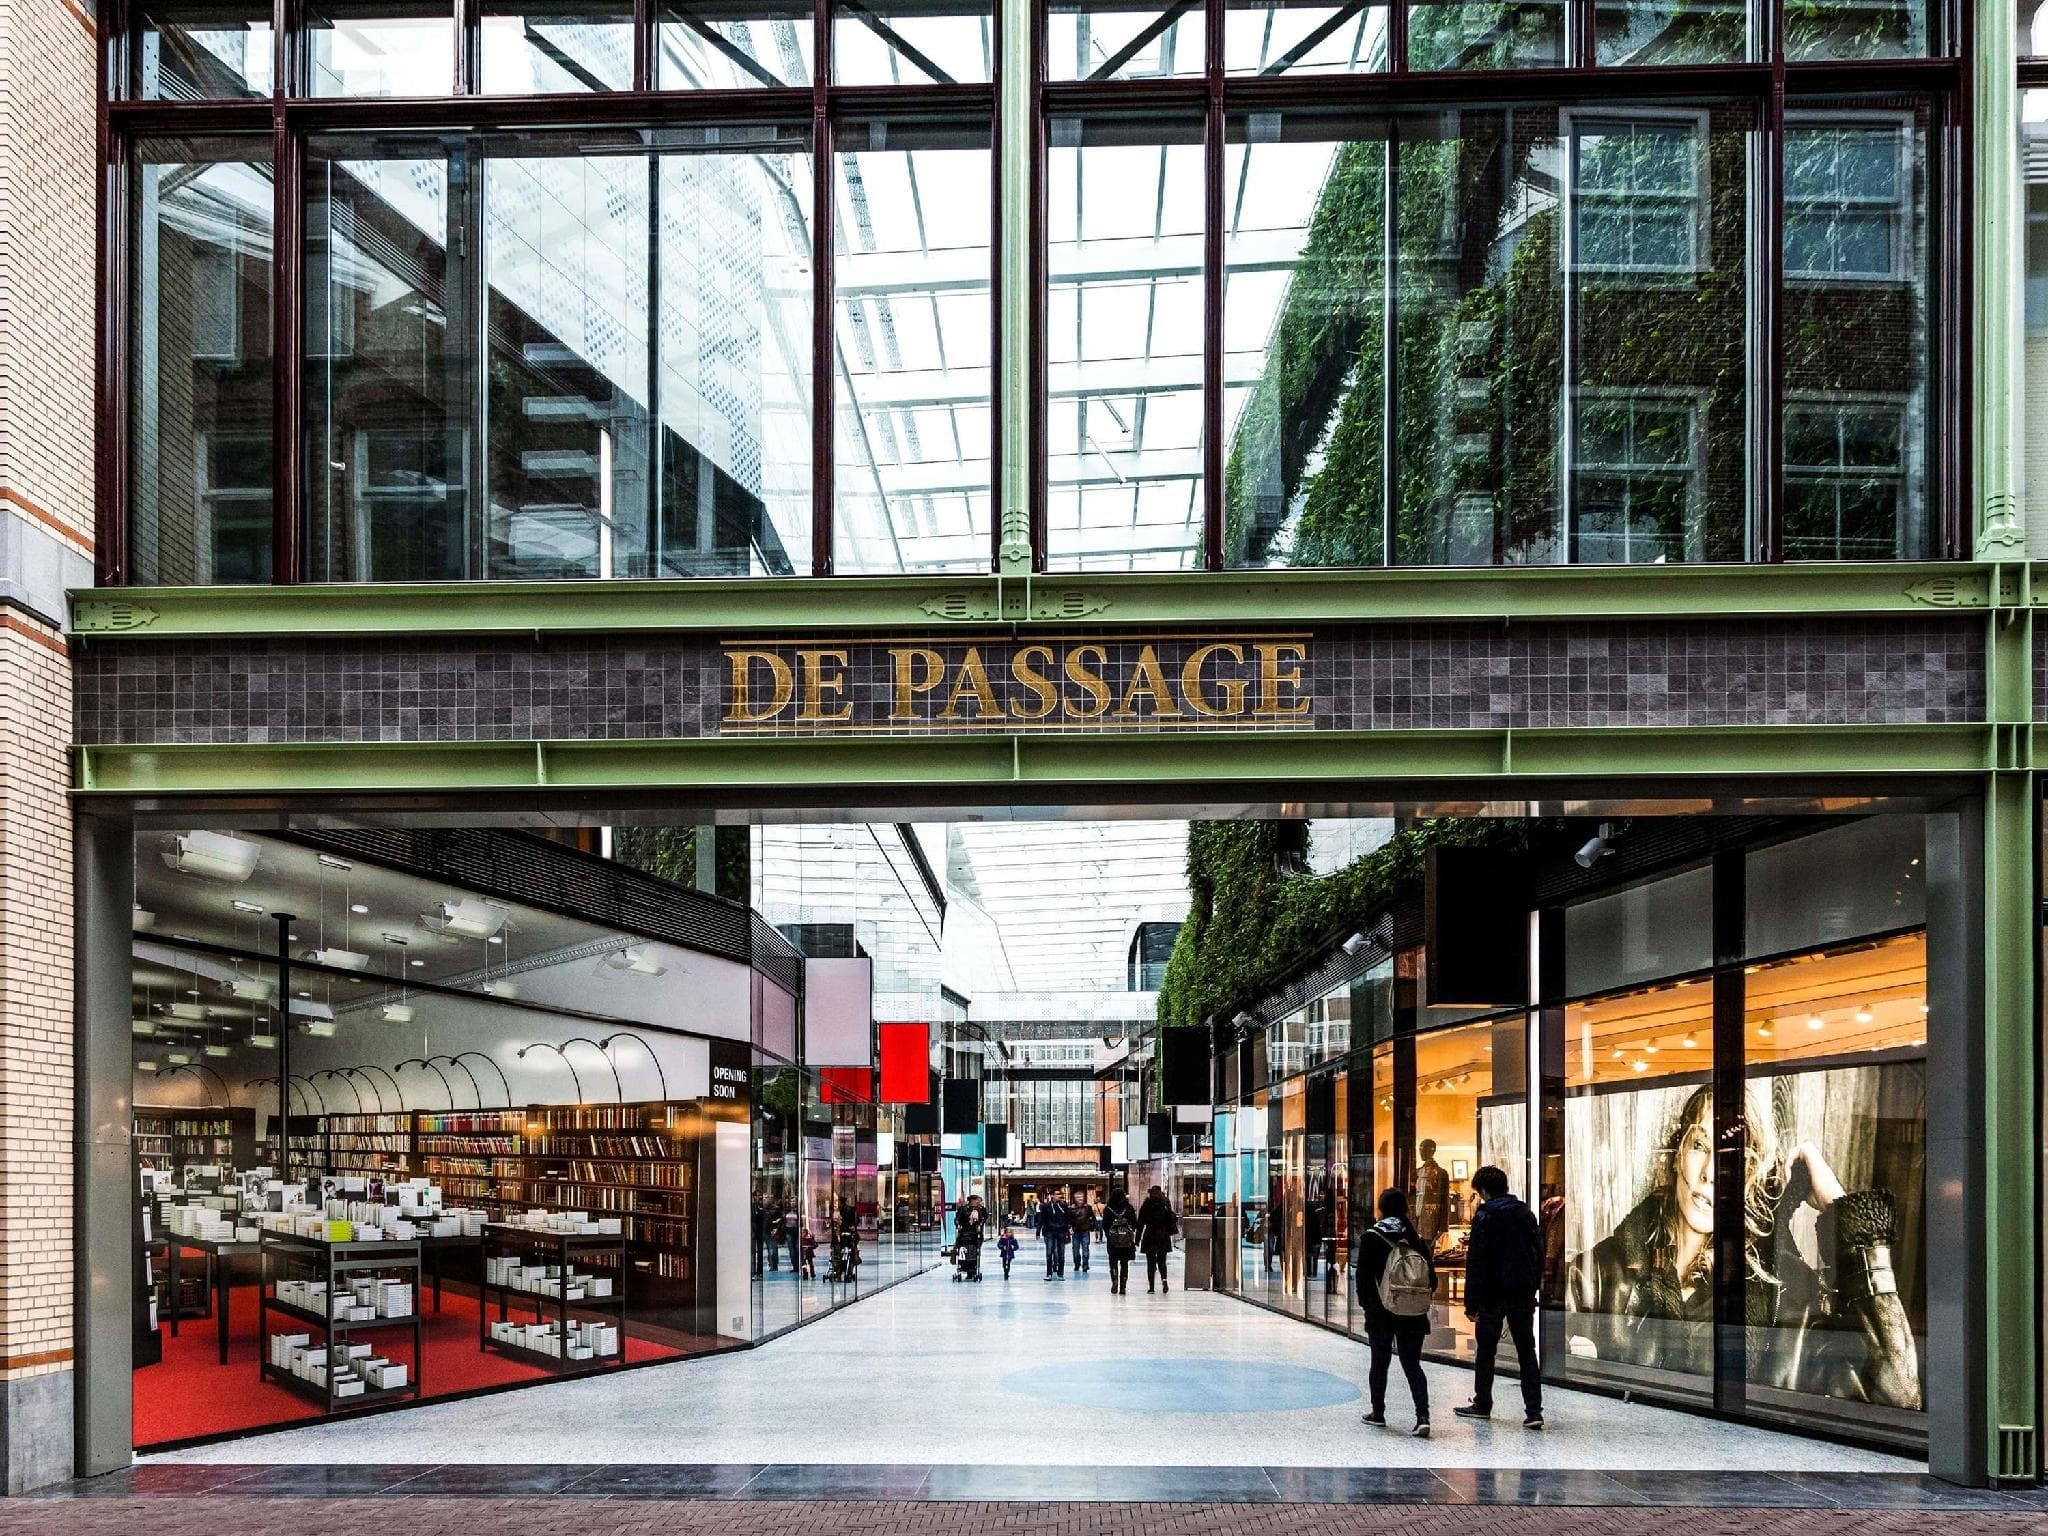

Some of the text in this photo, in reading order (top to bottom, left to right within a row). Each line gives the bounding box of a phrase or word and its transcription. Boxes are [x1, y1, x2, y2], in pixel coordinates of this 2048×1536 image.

[723, 643, 1312, 721] DE PASSAGE
[713, 1066, 747, 1083] OPENING
[713, 1084, 736, 1099] SOON
